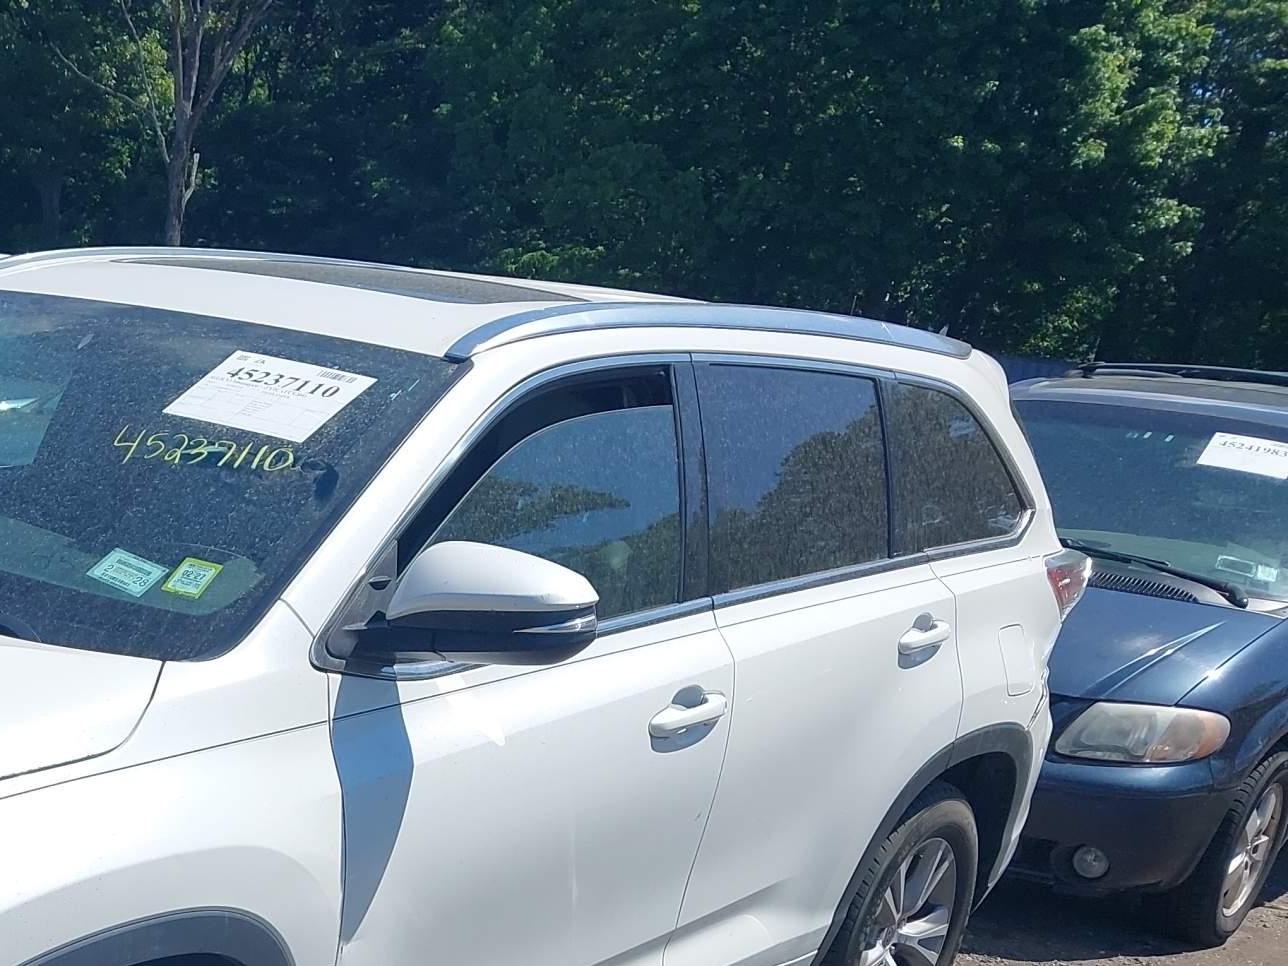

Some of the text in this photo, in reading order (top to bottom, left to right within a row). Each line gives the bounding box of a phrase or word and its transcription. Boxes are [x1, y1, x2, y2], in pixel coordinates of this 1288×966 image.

[227, 366, 341, 398] 45237110
[113, 424, 296, 472] 45237110
[1219, 440, 1288, 457] 45241983
